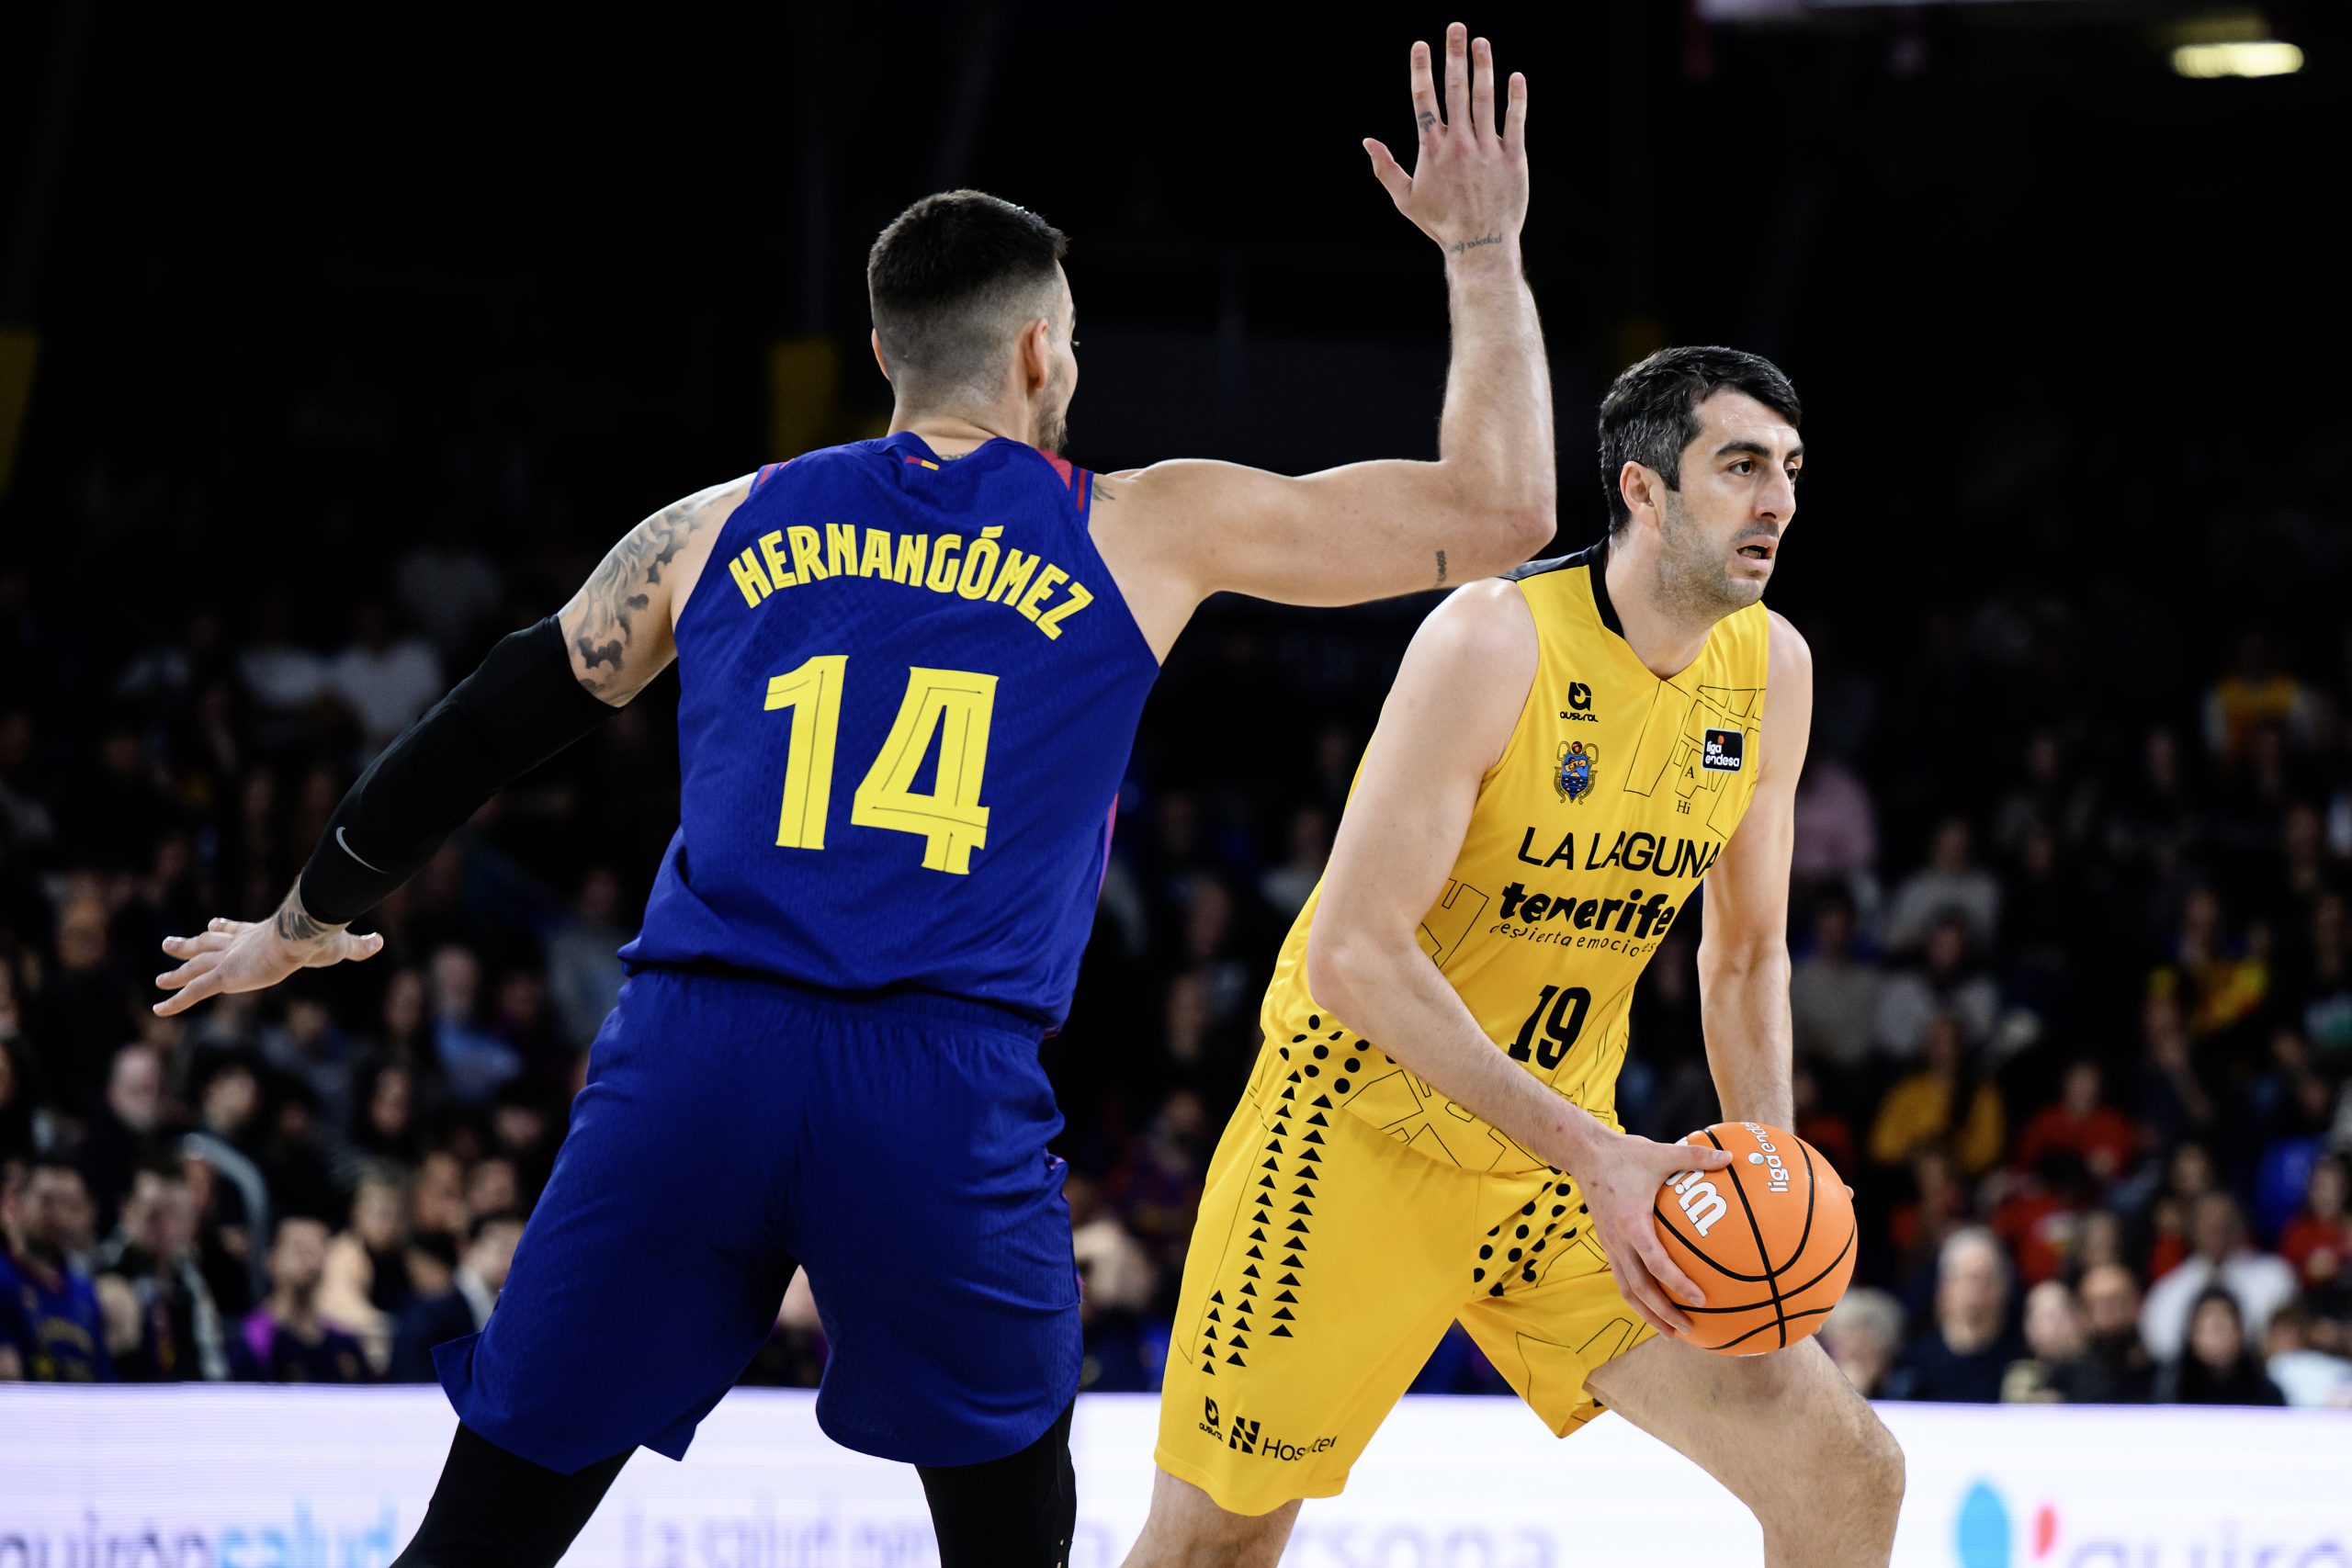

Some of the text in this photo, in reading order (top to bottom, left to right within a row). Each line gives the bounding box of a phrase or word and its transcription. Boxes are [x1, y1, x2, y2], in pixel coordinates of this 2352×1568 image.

[729, 523, 1094, 641] HERNANGÓMEZ
[1559, 711, 1600, 723] austral
[763, 654, 1000, 875] 14
[1704, 754, 1740, 768] endesa
[1706, 740, 1723, 755] liga
[1684, 766, 1695, 779] A
[1676, 800, 1691, 815] Hi
[1518, 826, 1722, 878] LA LAGUNA
[1499, 881, 1676, 940] tenerife
[1507, 984, 1591, 1070] 19
[1767, 1155, 1790, 1192] liga
